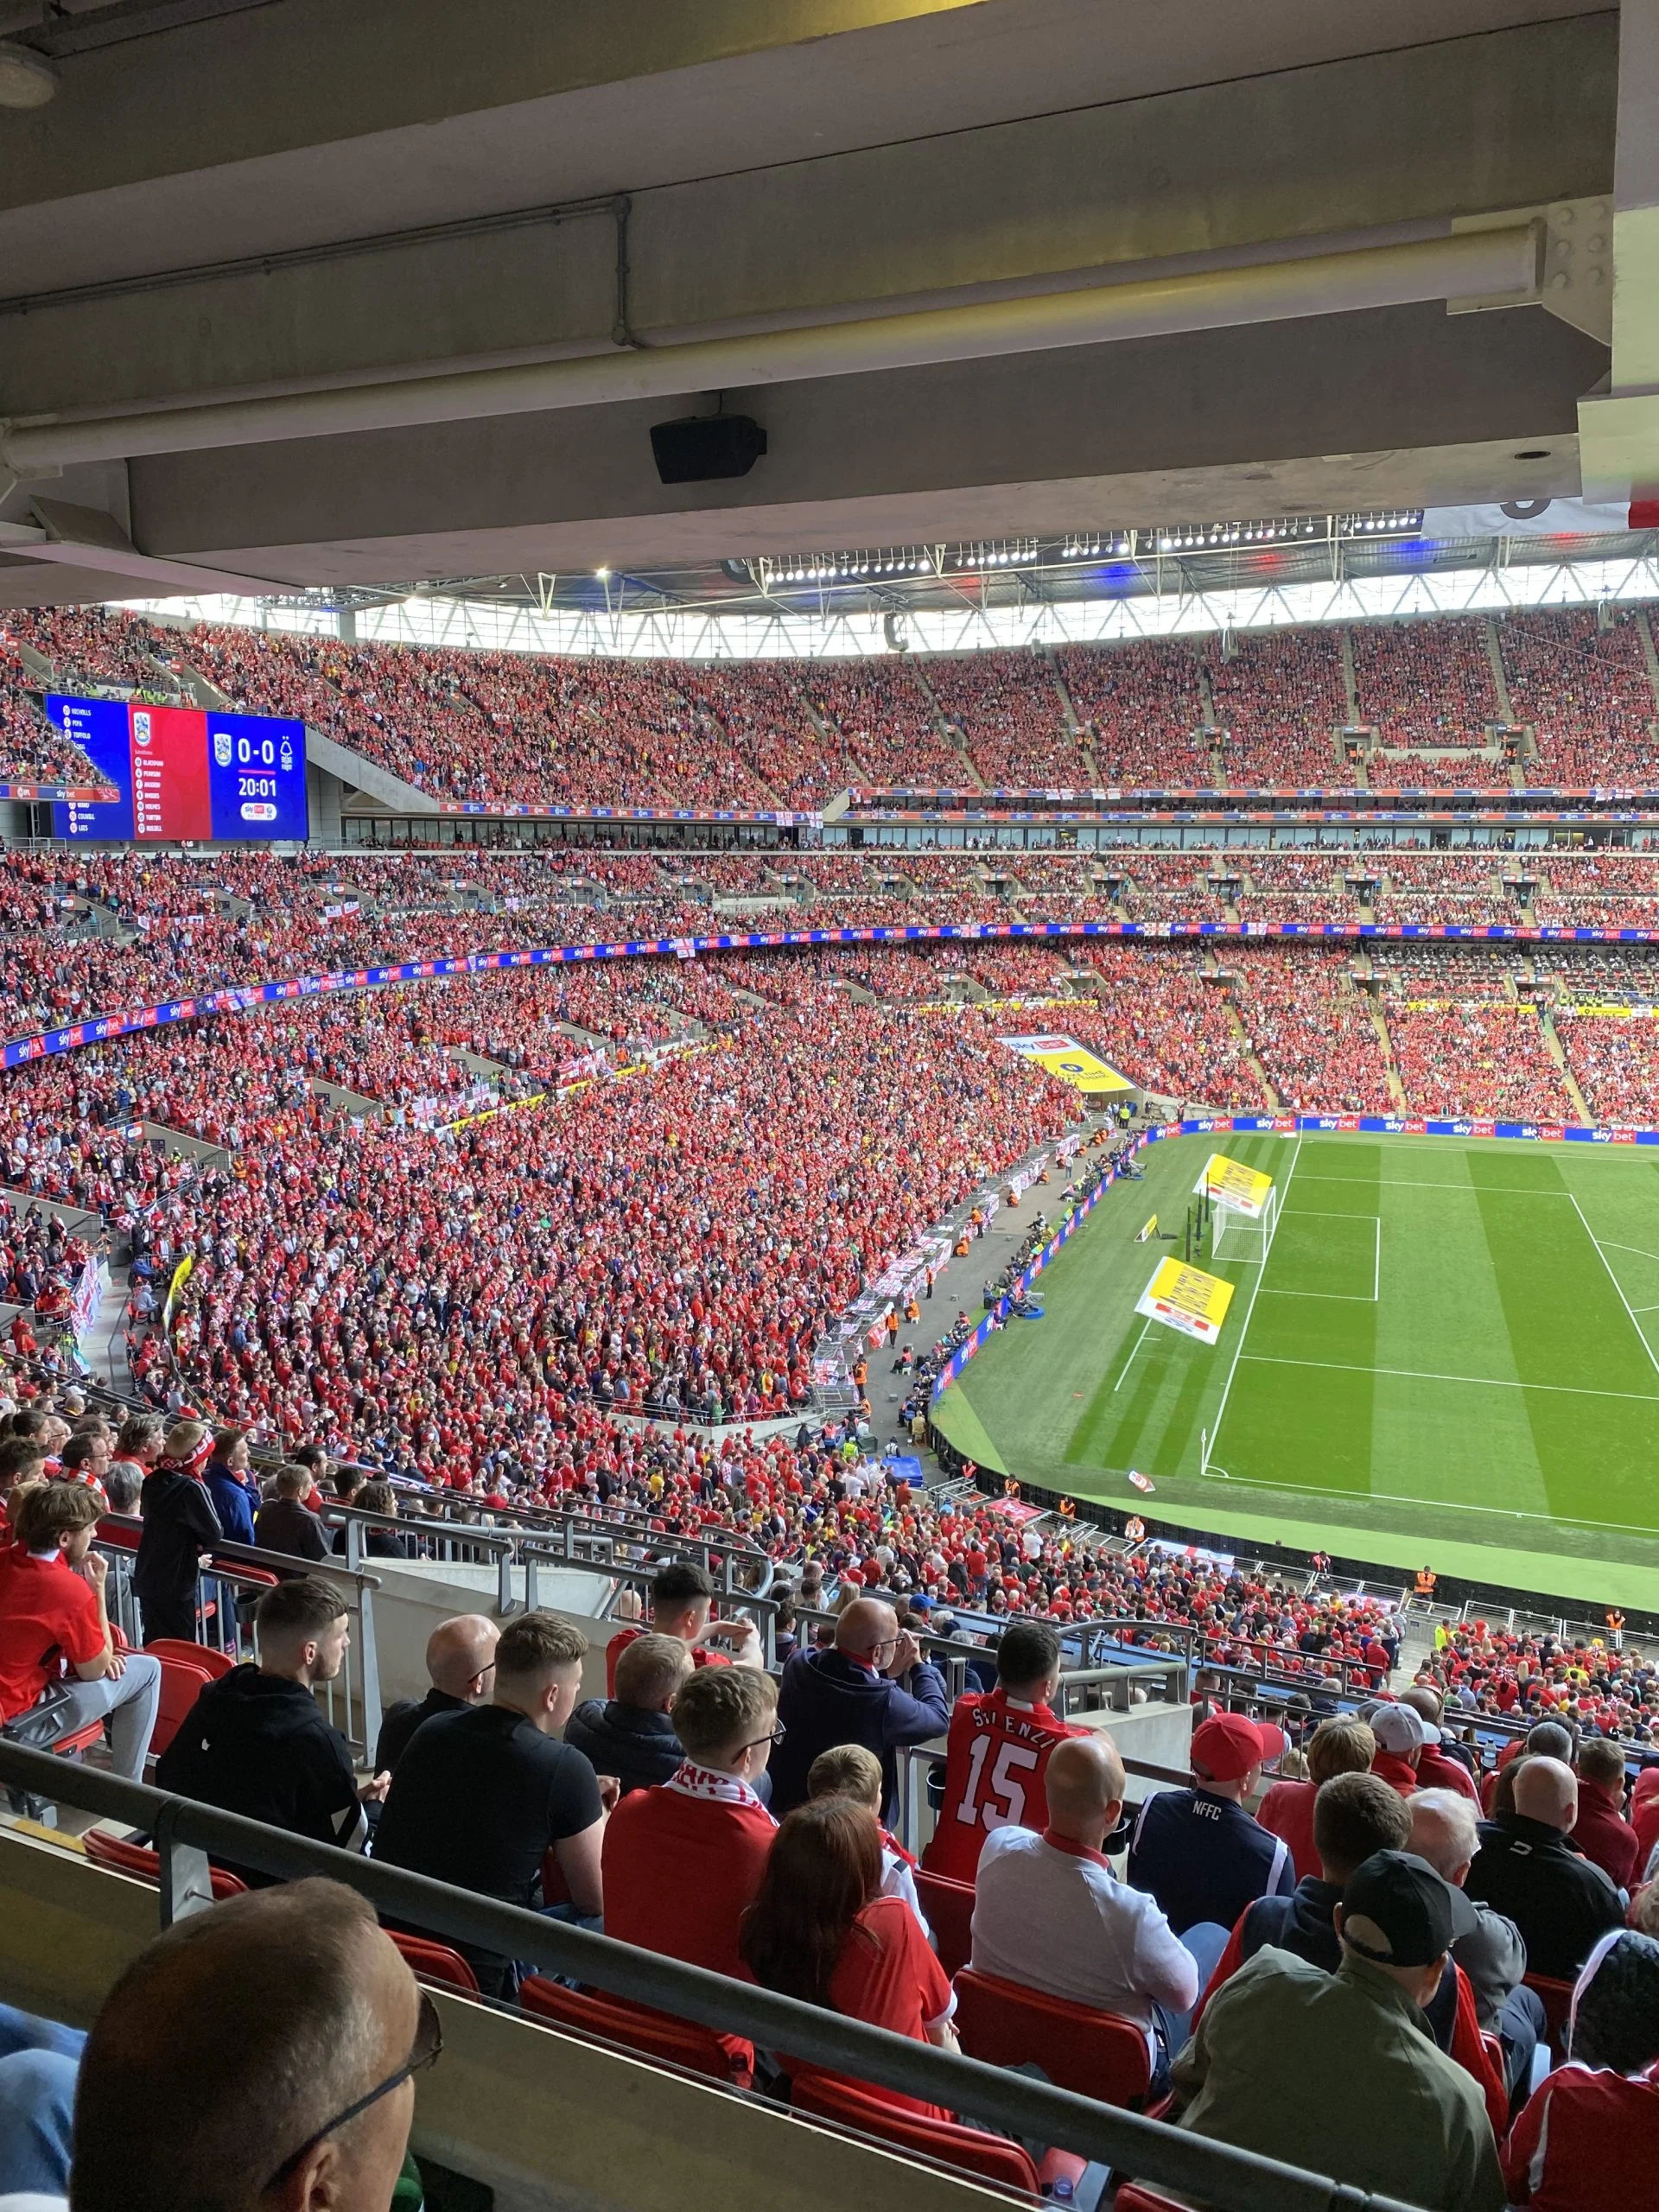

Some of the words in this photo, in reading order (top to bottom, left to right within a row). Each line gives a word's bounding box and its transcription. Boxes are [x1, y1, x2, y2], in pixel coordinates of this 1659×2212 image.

[238, 778, 276, 797] 20:01
[56, 790, 66, 798] sky
[885, 930, 893, 938] sky
[918, 928, 927, 937] sky
[1097, 925, 1108, 933] sky
[1175, 925, 1185, 933] sky
[1215, 925, 1227, 933] sky
[1418, 926, 1429, 935] sky
[1503, 928, 1516, 937] sky
[1592, 930, 1604, 938] sky
[791, 933, 799, 942] sky
[821, 931, 830, 940] sky
[852, 931, 861, 939] sky
[637, 943, 646, 951] sky
[699, 938, 709, 947] sky
[543, 951, 551, 961] sky
[552, 950, 561, 959] bet
[574, 949, 583, 958] sky
[607, 945, 615, 956] sky
[615, 945, 625, 954] bet
[478, 958, 487, 968] sky
[489, 957, 499, 965] bet
[511, 954, 519, 963] sky
[520, 953, 530, 962] bet
[413, 964, 422, 976] sky
[423, 963, 432, 972] bet
[446, 961, 454, 971] sky
[456, 960, 465, 969] bet
[346, 975, 354, 985] sky
[356, 973, 365, 982] bet
[378, 969, 389, 980] sky
[390, 969, 399, 978] bet
[276, 984, 286, 996] sky
[288, 983, 297, 994] bet
[311, 979, 320, 990] sky
[321, 978, 330, 988] be
[145, 1010, 156, 1021] bet
[170, 1004, 180, 1018] sky
[181, 1002, 192, 1014] bet
[95, 1021, 107, 1035] sky
[59, 1033, 69, 1046] sky
[71, 1030, 81, 1042] bet
[1011, 1042, 1035, 1051] sky
[1039, 1039, 1066, 1049] bet
[19, 1044, 29, 1058] sky
[1198, 1120, 1214, 1132] sky
[1215, 1120, 1230, 1128] bet
[1256, 1118, 1274, 1130] sky
[1275, 1118, 1293, 1128] bet
[1319, 1118, 1338, 1130] sky
[1339, 1119, 1357, 1128] bet
[1386, 1120, 1404, 1132] sky
[1407, 1121, 1424, 1131] bet
[1453, 1123, 1472, 1135] sky
[1474, 1124, 1493, 1134] bet
[1156, 1127, 1166, 1139] sky
[1167, 1125, 1179, 1135] bet
[1522, 1127, 1537, 1136] sk
[1543, 1128, 1562, 1138] bet
[1592, 1130, 1611, 1142] sky
[1614, 1130, 1633, 1141] bet
[957, 1734, 1038, 1832] 15
[1192, 1801, 1222, 1821] NFFC
